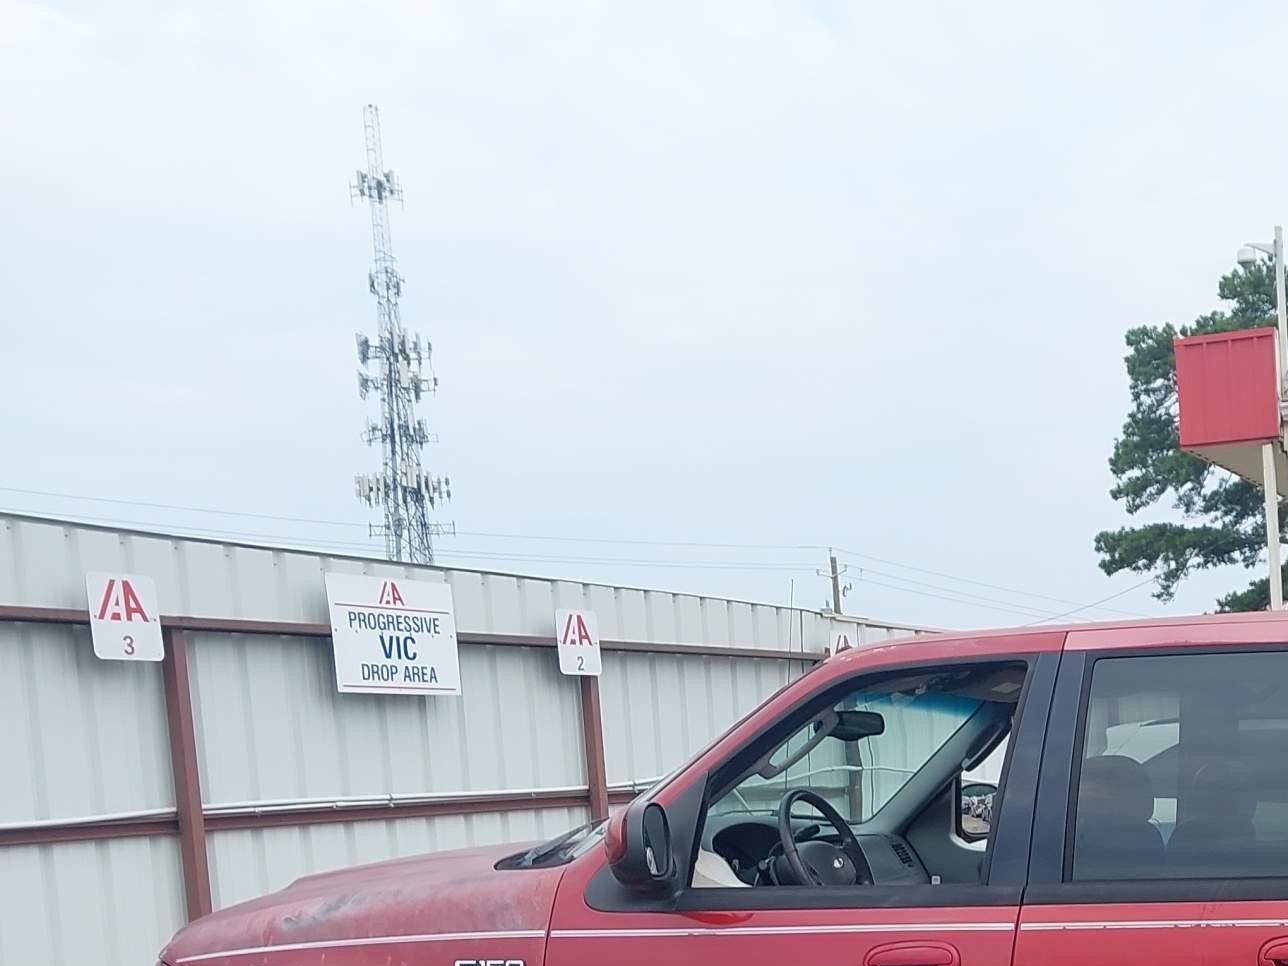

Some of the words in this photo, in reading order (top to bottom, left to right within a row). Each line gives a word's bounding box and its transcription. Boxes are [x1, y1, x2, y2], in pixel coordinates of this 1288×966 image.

[347, 610, 441, 635] PROGRESSIVE
[122, 634, 136, 656] 3
[378, 634, 418, 661] VIC
[361, 663, 398, 682] DROP
[403, 665, 438, 684] AREA
[576, 655, 585, 672] 2
